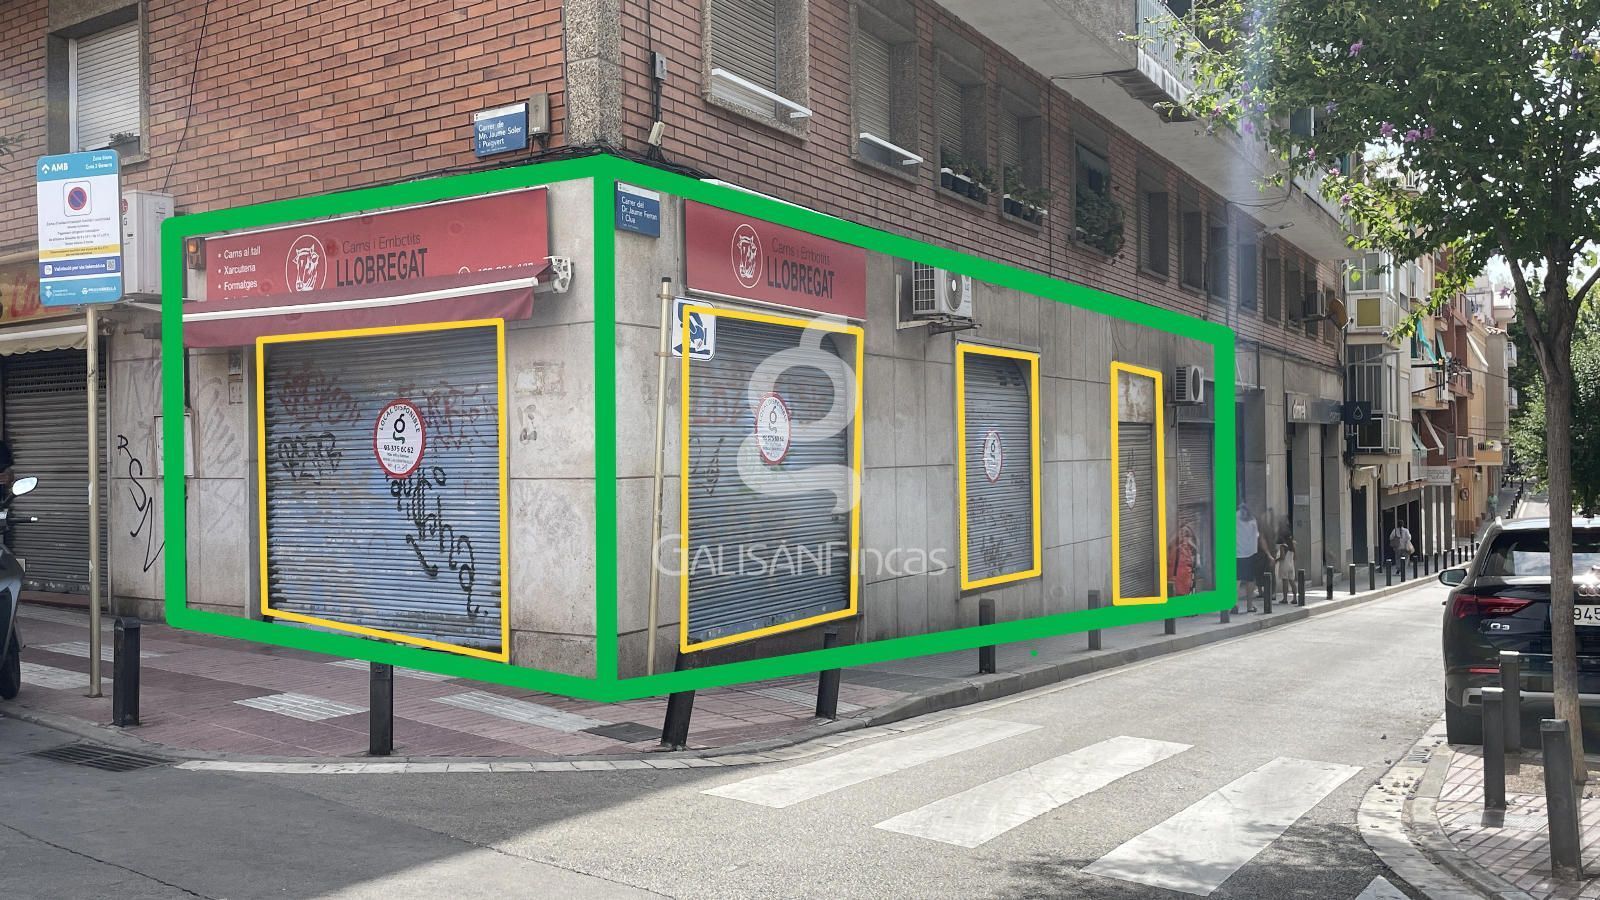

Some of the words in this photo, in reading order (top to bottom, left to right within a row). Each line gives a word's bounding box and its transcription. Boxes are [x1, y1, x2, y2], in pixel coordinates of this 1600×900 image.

[478, 124, 495, 132] Carrer
[489, 130, 506, 138] Jaume
[508, 126, 522, 135] Soler
[483, 138, 504, 148] Puigvert
[51, 163, 69, 172] AMB
[622, 196, 636, 206] Carrer
[625, 214, 636, 223] Clua
[629, 207, 643, 216] Jaume
[644, 211, 657, 220] Ferran
[342, 240, 370, 254] Carns
[378, 233, 421, 249] Embotits
[224, 250, 242, 259] Carns
[244, 247, 250, 256] al
[251, 245, 260, 255] tall
[771, 237, 795, 256] Carns
[801, 246, 830, 266] Embotits
[224, 264, 256, 275] Xarcuteria
[336, 248, 428, 287] LLOBREGAT
[767, 256, 835, 299] LLOBREGAT
[224, 280, 258, 291] Formatges
[380, 408, 393, 431] LOCAL
[394, 405, 420, 433] DISPONIBLE
